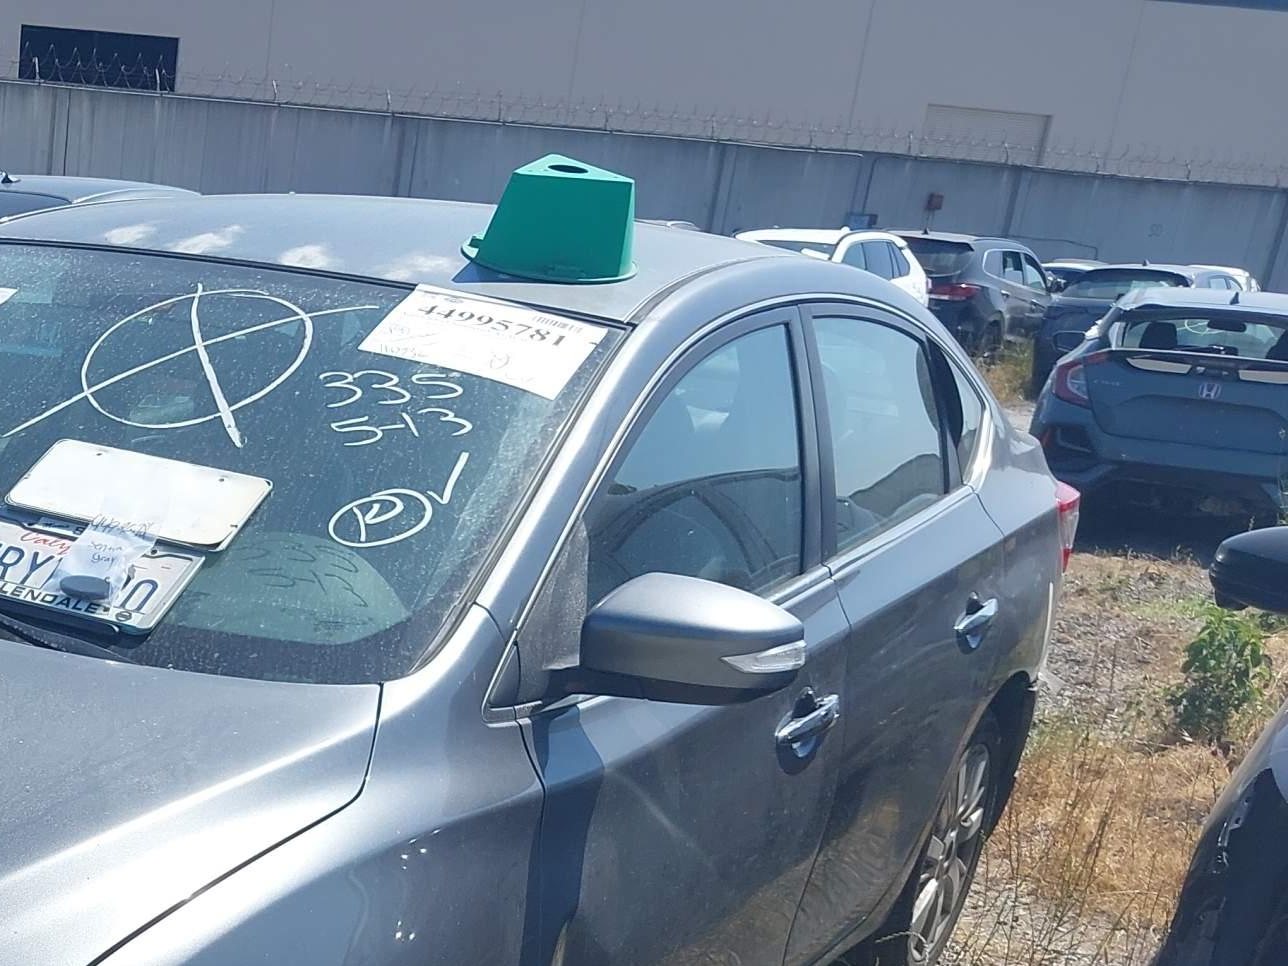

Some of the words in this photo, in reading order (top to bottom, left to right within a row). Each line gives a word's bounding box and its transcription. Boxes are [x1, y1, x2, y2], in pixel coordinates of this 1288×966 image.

[418, 304, 567, 346] 44995781
[319, 369, 464, 408] 335
[330, 407, 473, 446] 5-13
